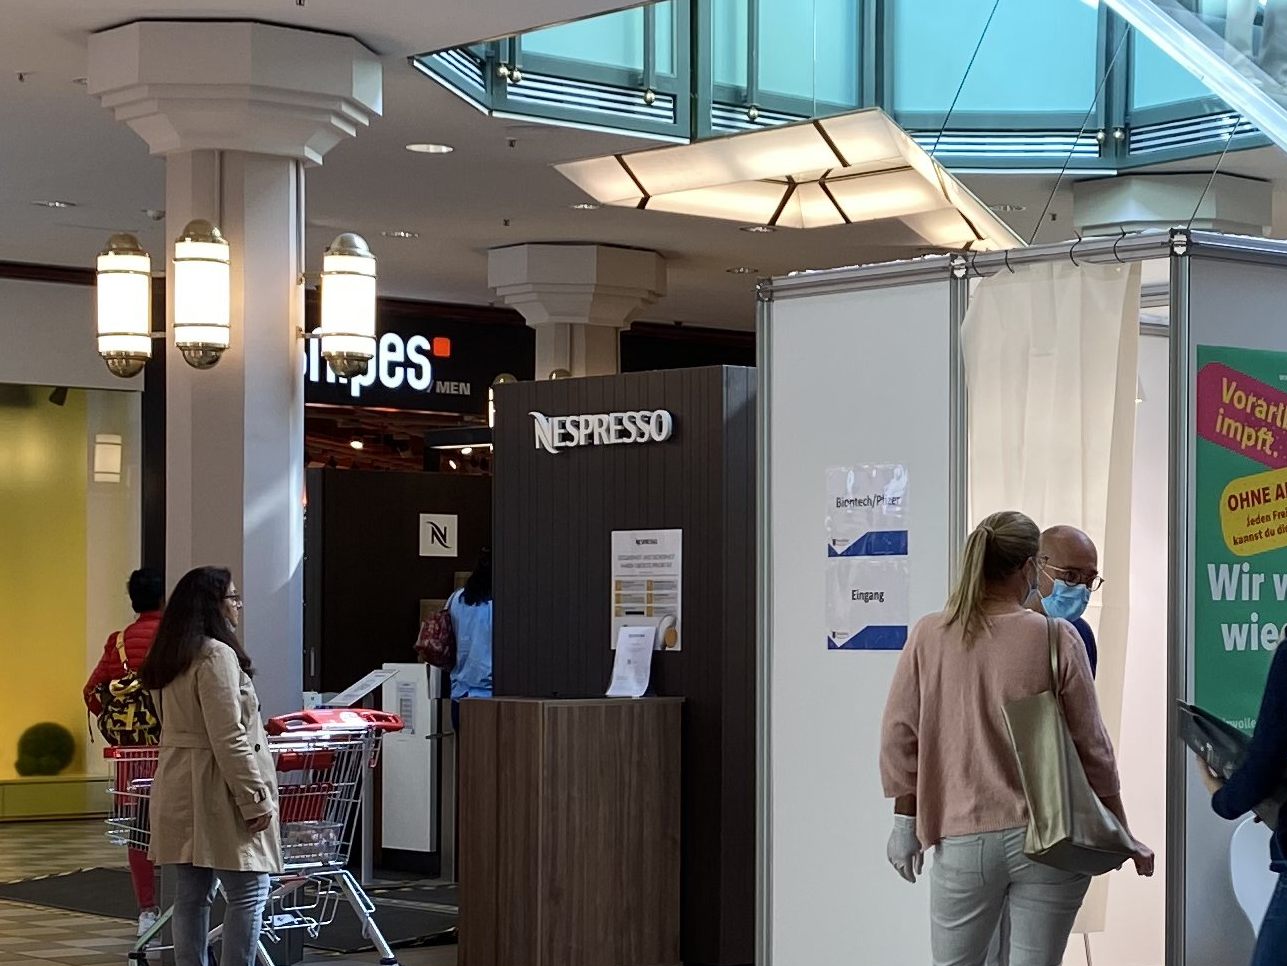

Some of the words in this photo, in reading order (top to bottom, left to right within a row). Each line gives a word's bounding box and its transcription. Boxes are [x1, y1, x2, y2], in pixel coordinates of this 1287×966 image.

[528, 409, 673, 453] NESPRESSO
[1215, 407, 1279, 458] impft.
[1227, 487, 1271, 512] OHNE
[1233, 530, 1263, 546] kannst
[1264, 527, 1276, 538] du
[851, 589, 885, 603] Eingang
[1207, 562, 1265, 601] Wir
